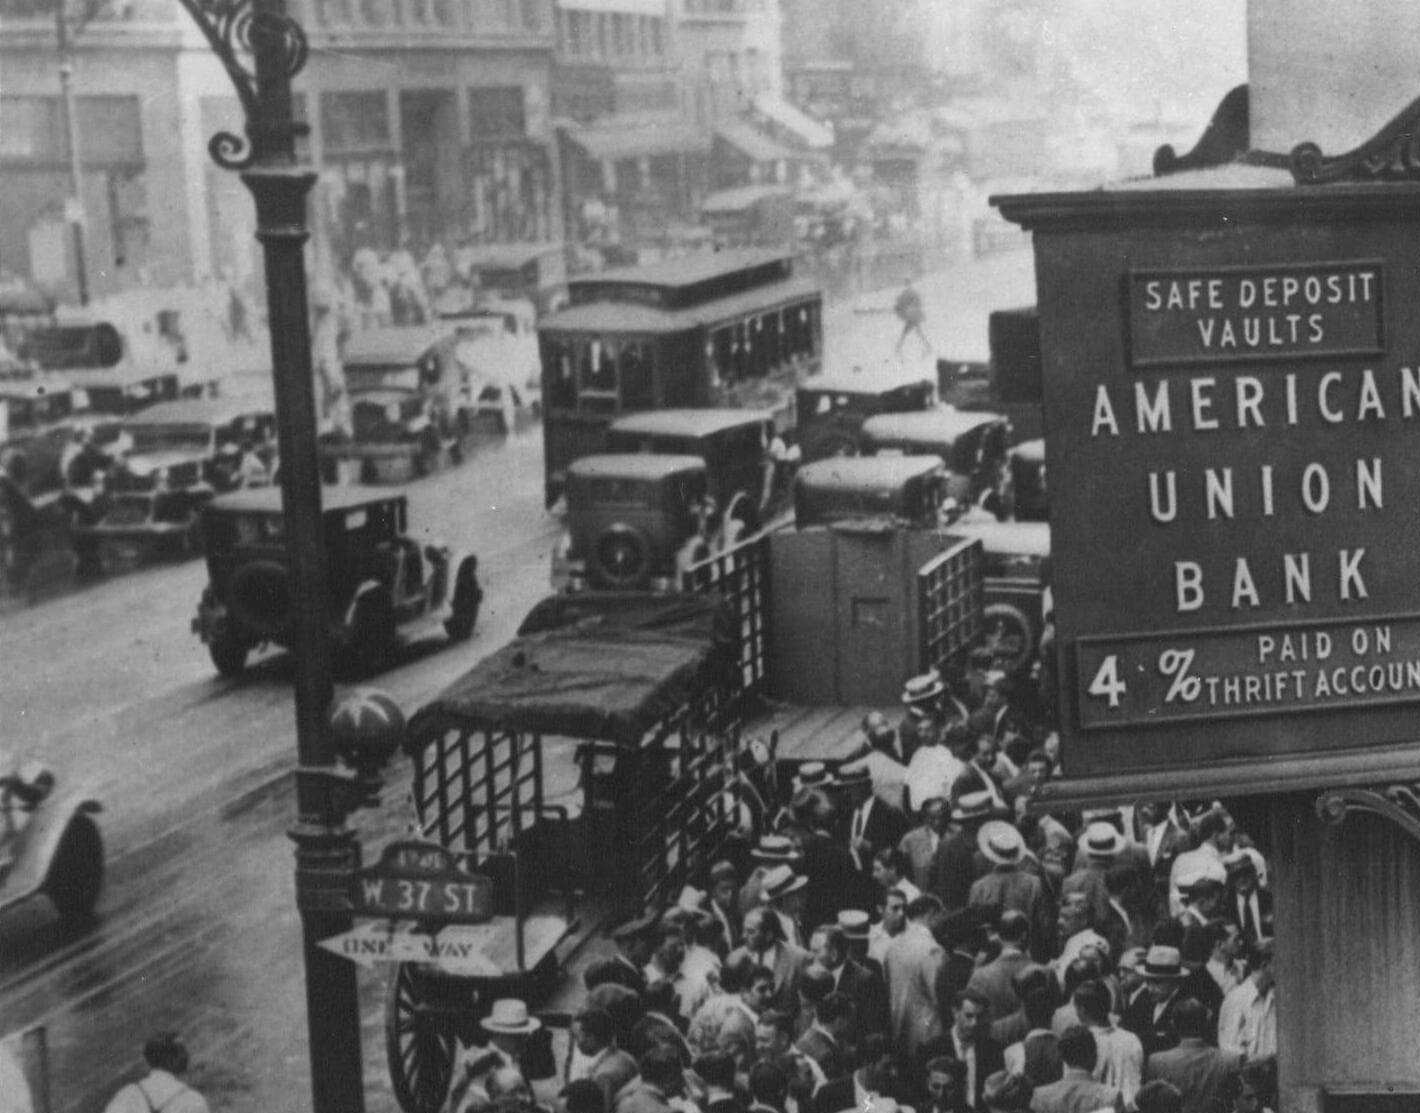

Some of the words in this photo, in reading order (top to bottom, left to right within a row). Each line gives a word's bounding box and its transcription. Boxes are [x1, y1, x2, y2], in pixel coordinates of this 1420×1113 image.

[1146, 280, 1223, 310] SAFE
[1239, 272, 1375, 308] DEPOSIT
[1198, 314, 1324, 348] VAULTS
[1149, 457, 1384, 522] UNION
[1175, 548, 1368, 611] BANK
[1258, 631, 1332, 663] PAID
[1352, 627, 1391, 655] ON
[1207, 670, 1306, 704] THRIFT
[398, 880, 431, 911] 37
[423, 940, 472, 956] WAY
